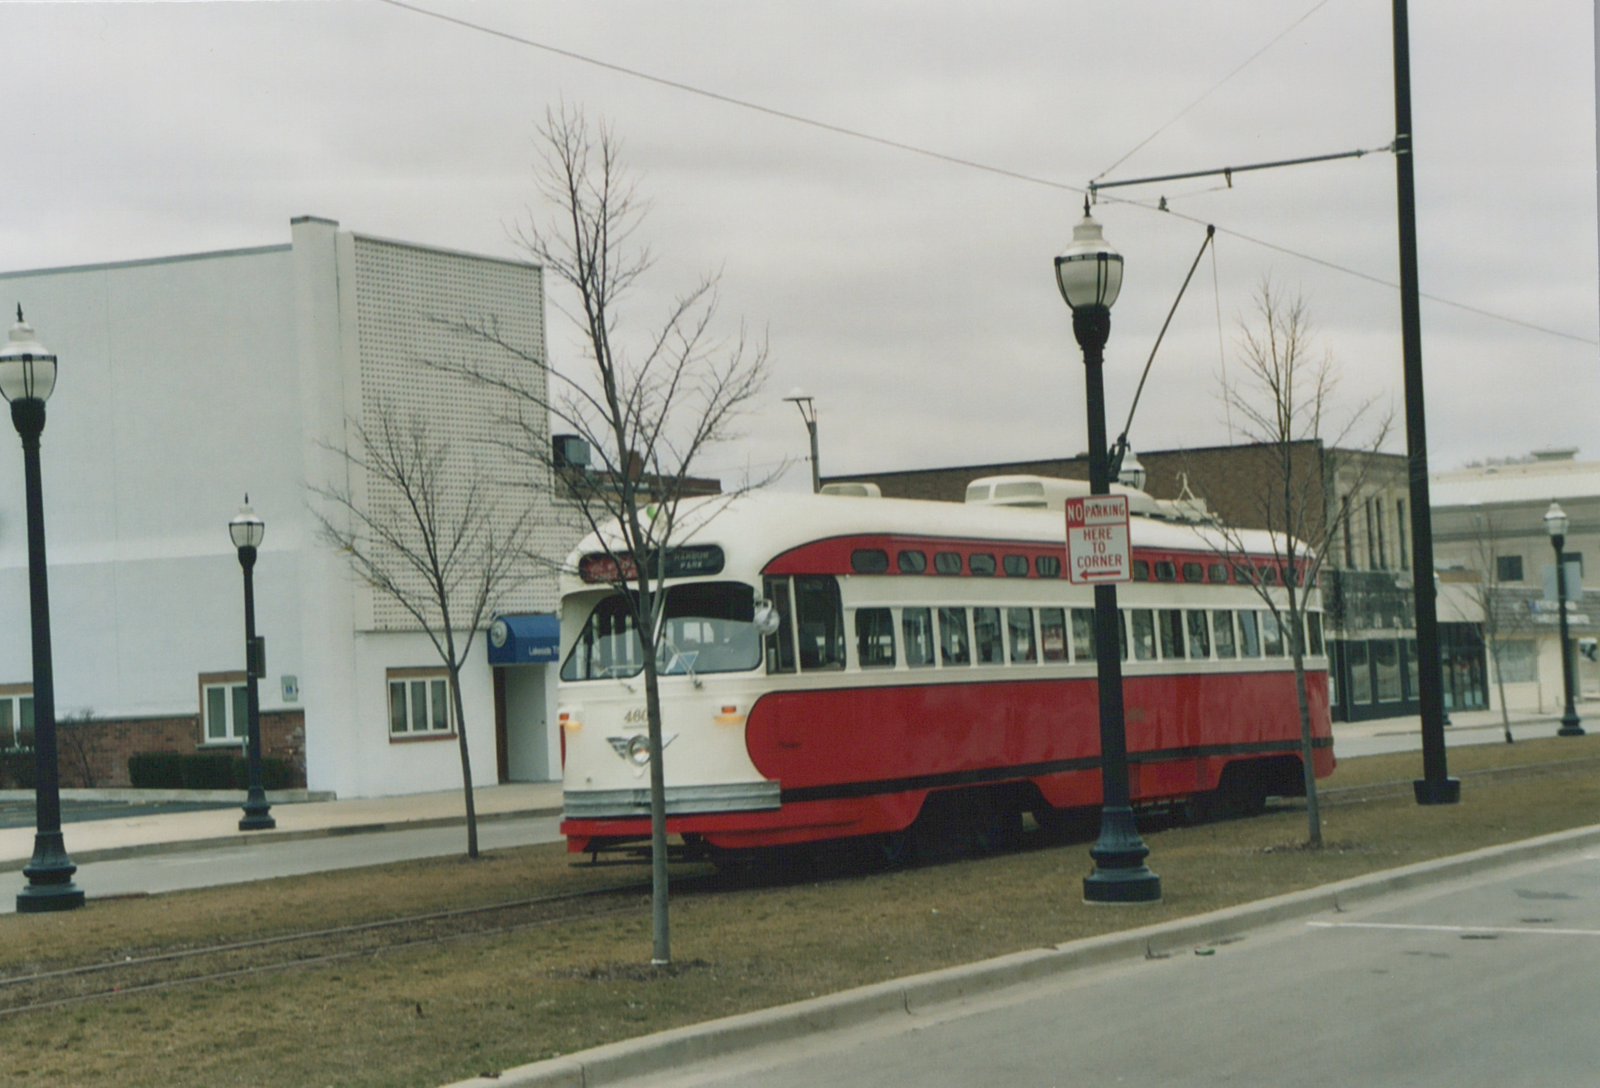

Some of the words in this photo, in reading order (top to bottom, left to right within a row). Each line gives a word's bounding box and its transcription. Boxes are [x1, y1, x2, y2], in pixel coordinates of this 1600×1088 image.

[1067, 503, 1083, 523] NO
[1085, 503, 1125, 518] PARKING
[1083, 527, 1112, 541] HERE
[1092, 541, 1106, 554] TO
[1077, 554, 1122, 568] CORNER
